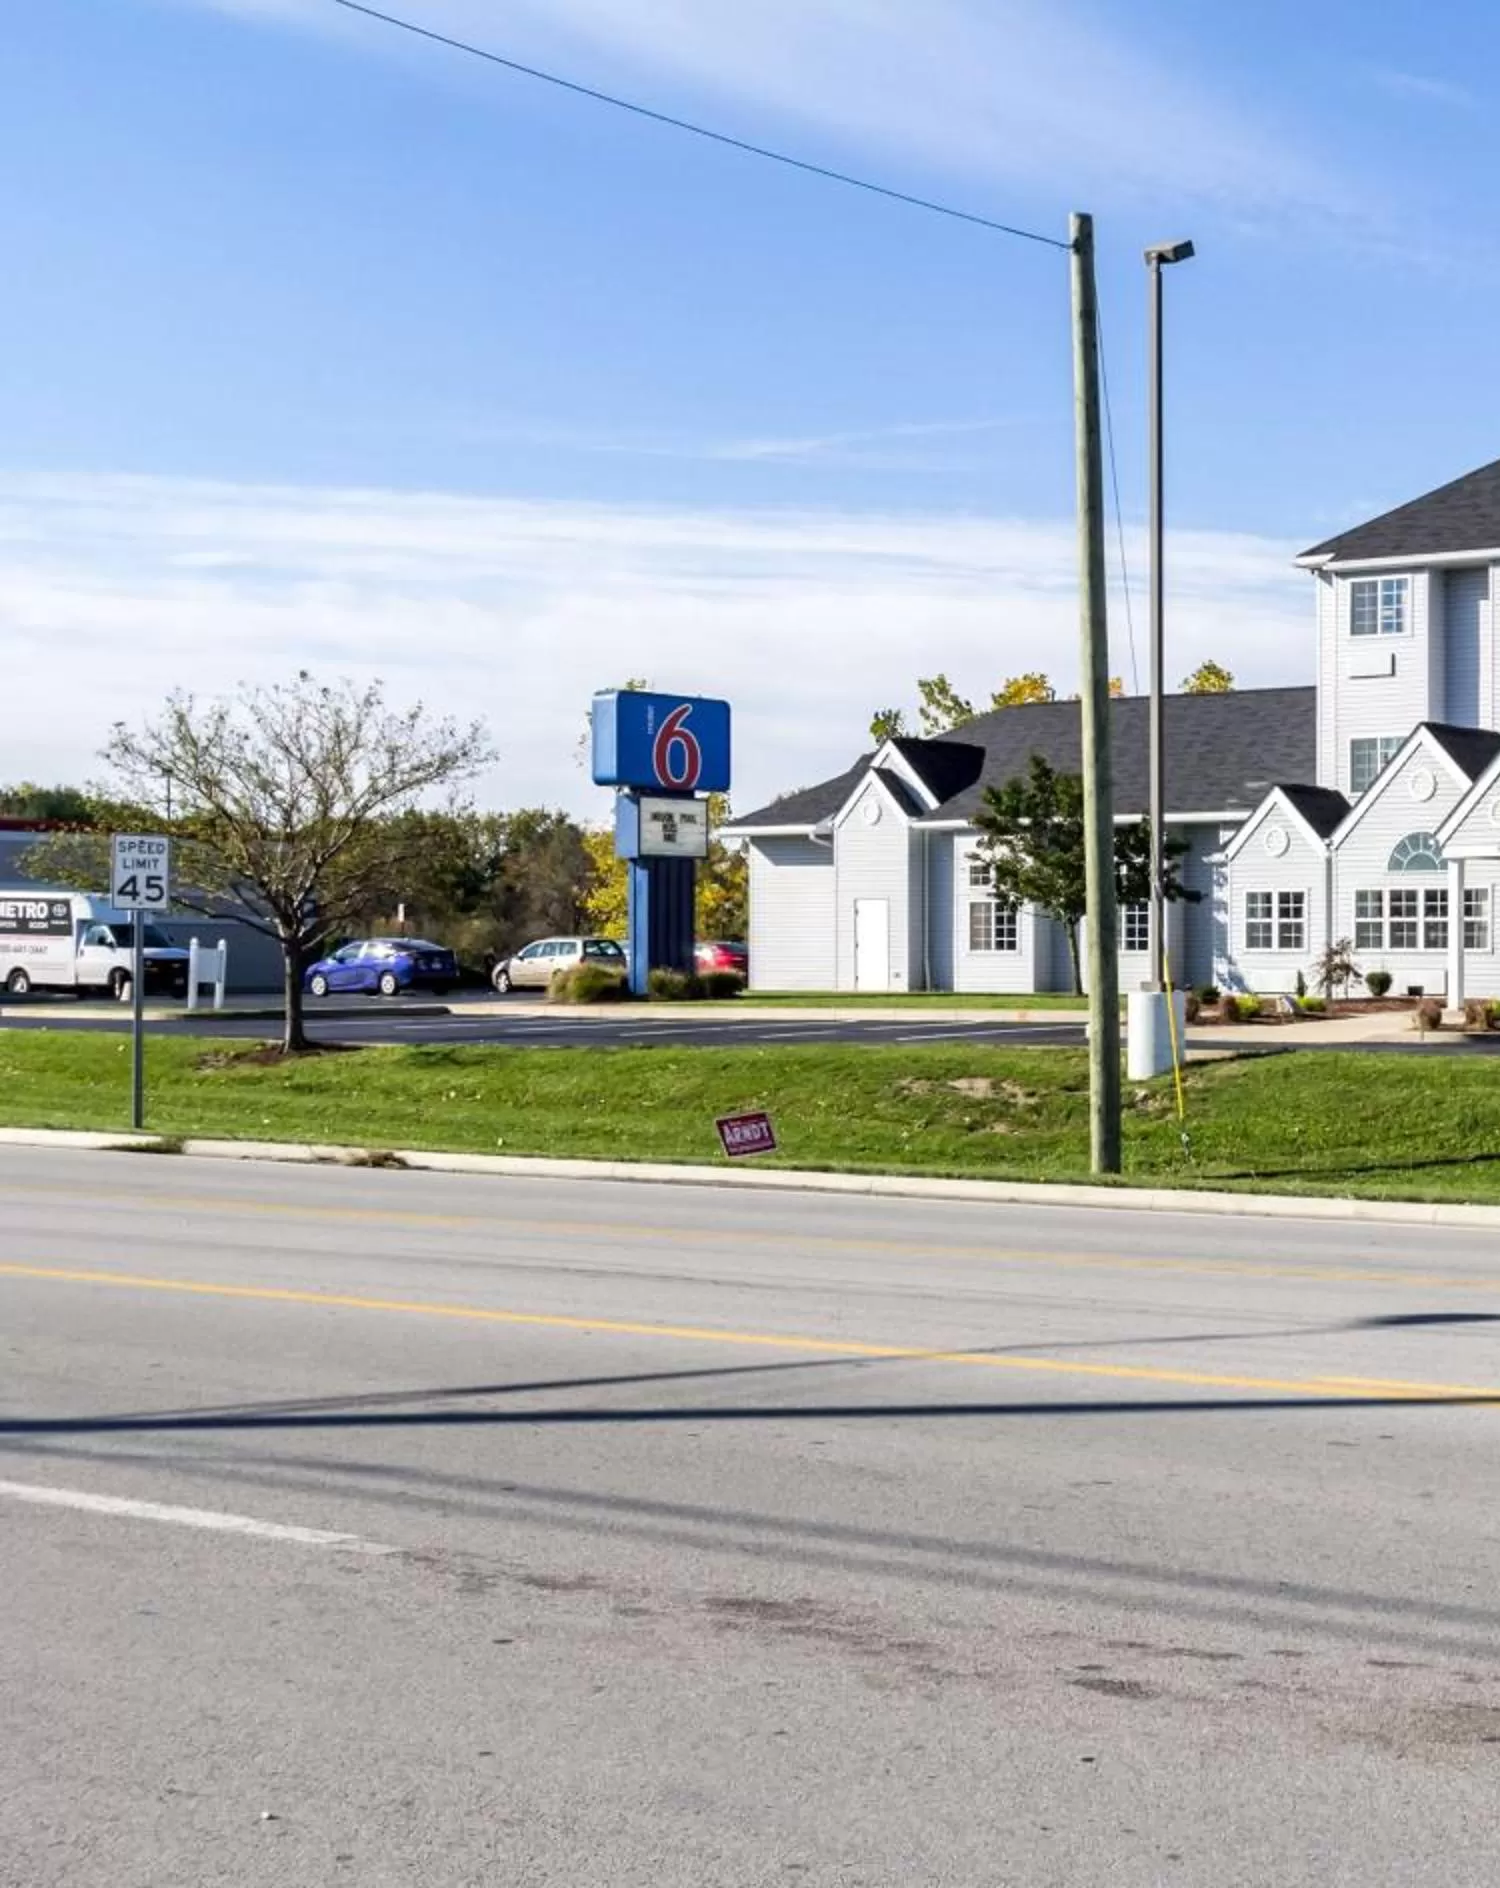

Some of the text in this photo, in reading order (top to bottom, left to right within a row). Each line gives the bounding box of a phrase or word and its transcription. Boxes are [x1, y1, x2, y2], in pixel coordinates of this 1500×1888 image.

[652, 703, 702, 790] 6
[118, 840, 165, 855] SPEED
[123, 858, 160, 869] LIMIT
[117, 875, 165, 902] 45
